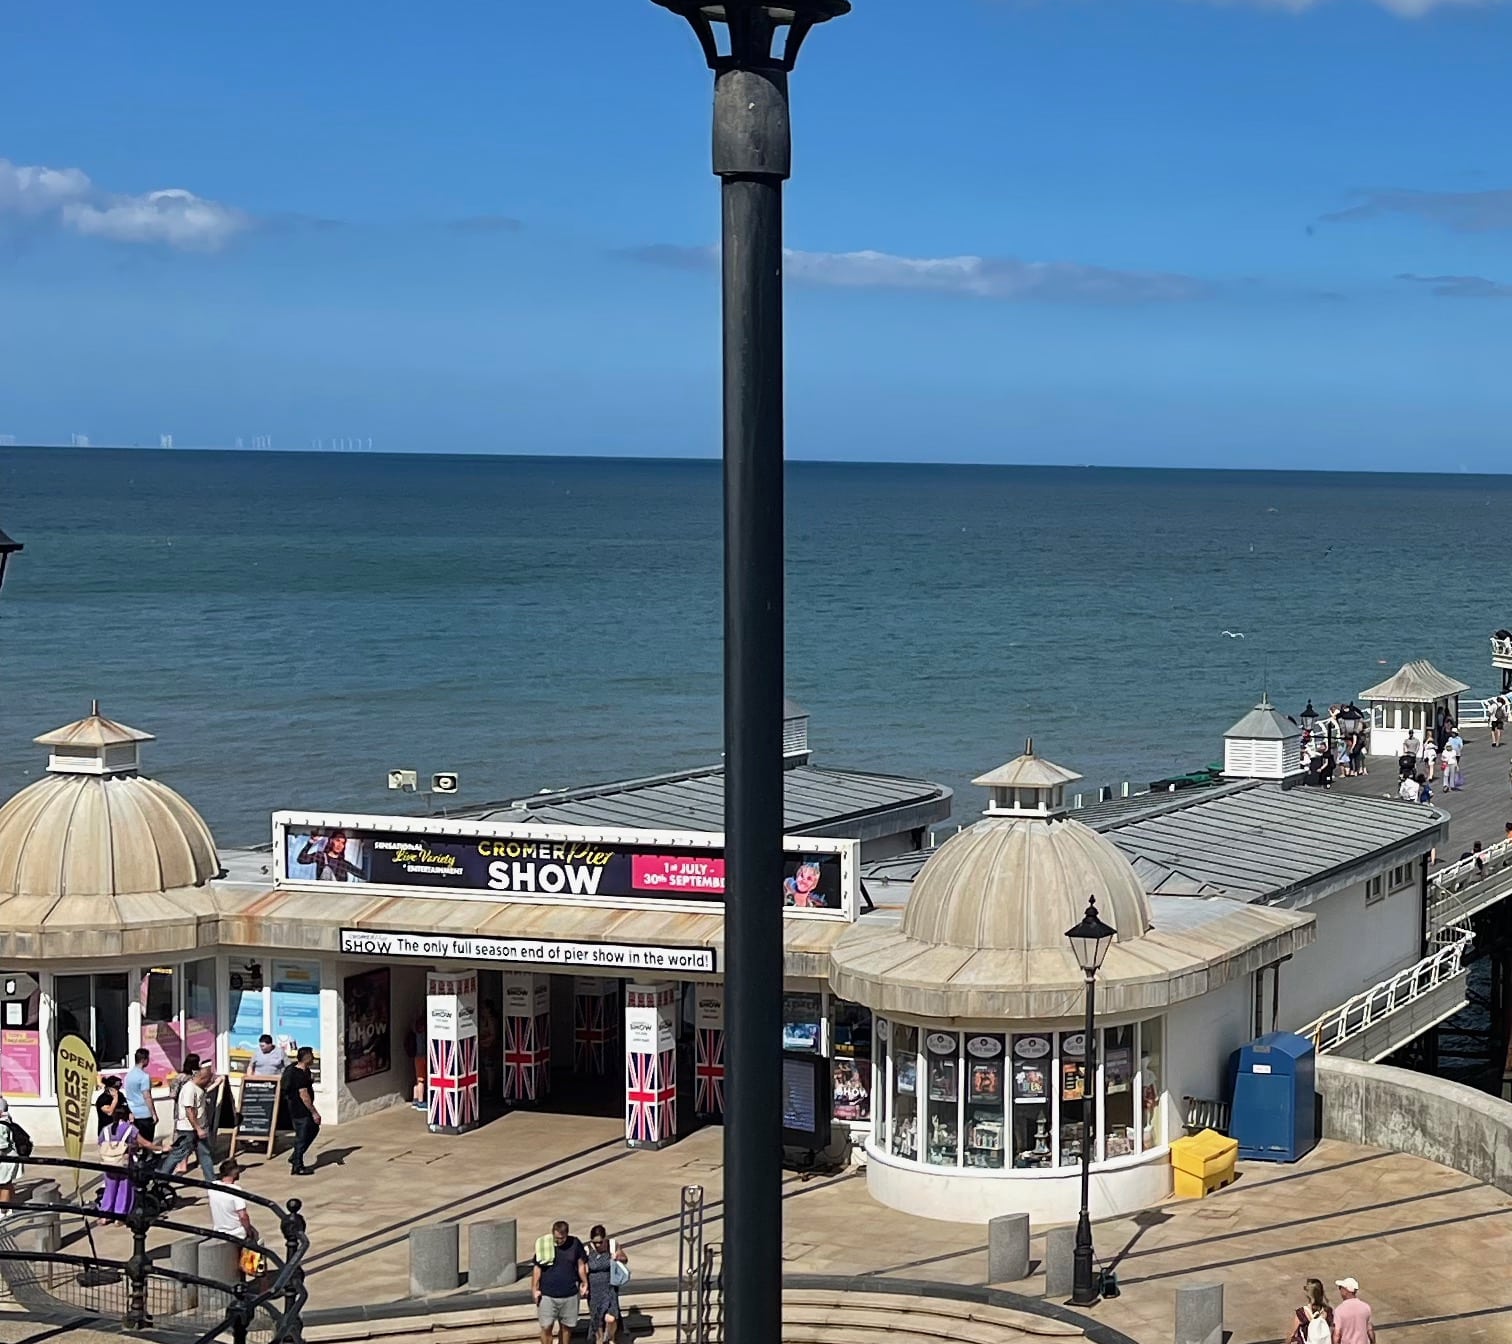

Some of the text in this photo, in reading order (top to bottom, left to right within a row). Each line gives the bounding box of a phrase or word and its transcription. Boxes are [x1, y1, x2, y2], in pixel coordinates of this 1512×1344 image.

[478, 840, 616, 865] CROMER Pier
[487, 860, 603, 895] SHOW
[679, 863, 709, 876] JULY
[344, 939, 393, 953] SHOW
[397, 938, 709, 968] The only full season end of pier show in the world!
[60, 1048, 94, 1072] OPEN
[65, 1068, 80, 1138] TIDES
